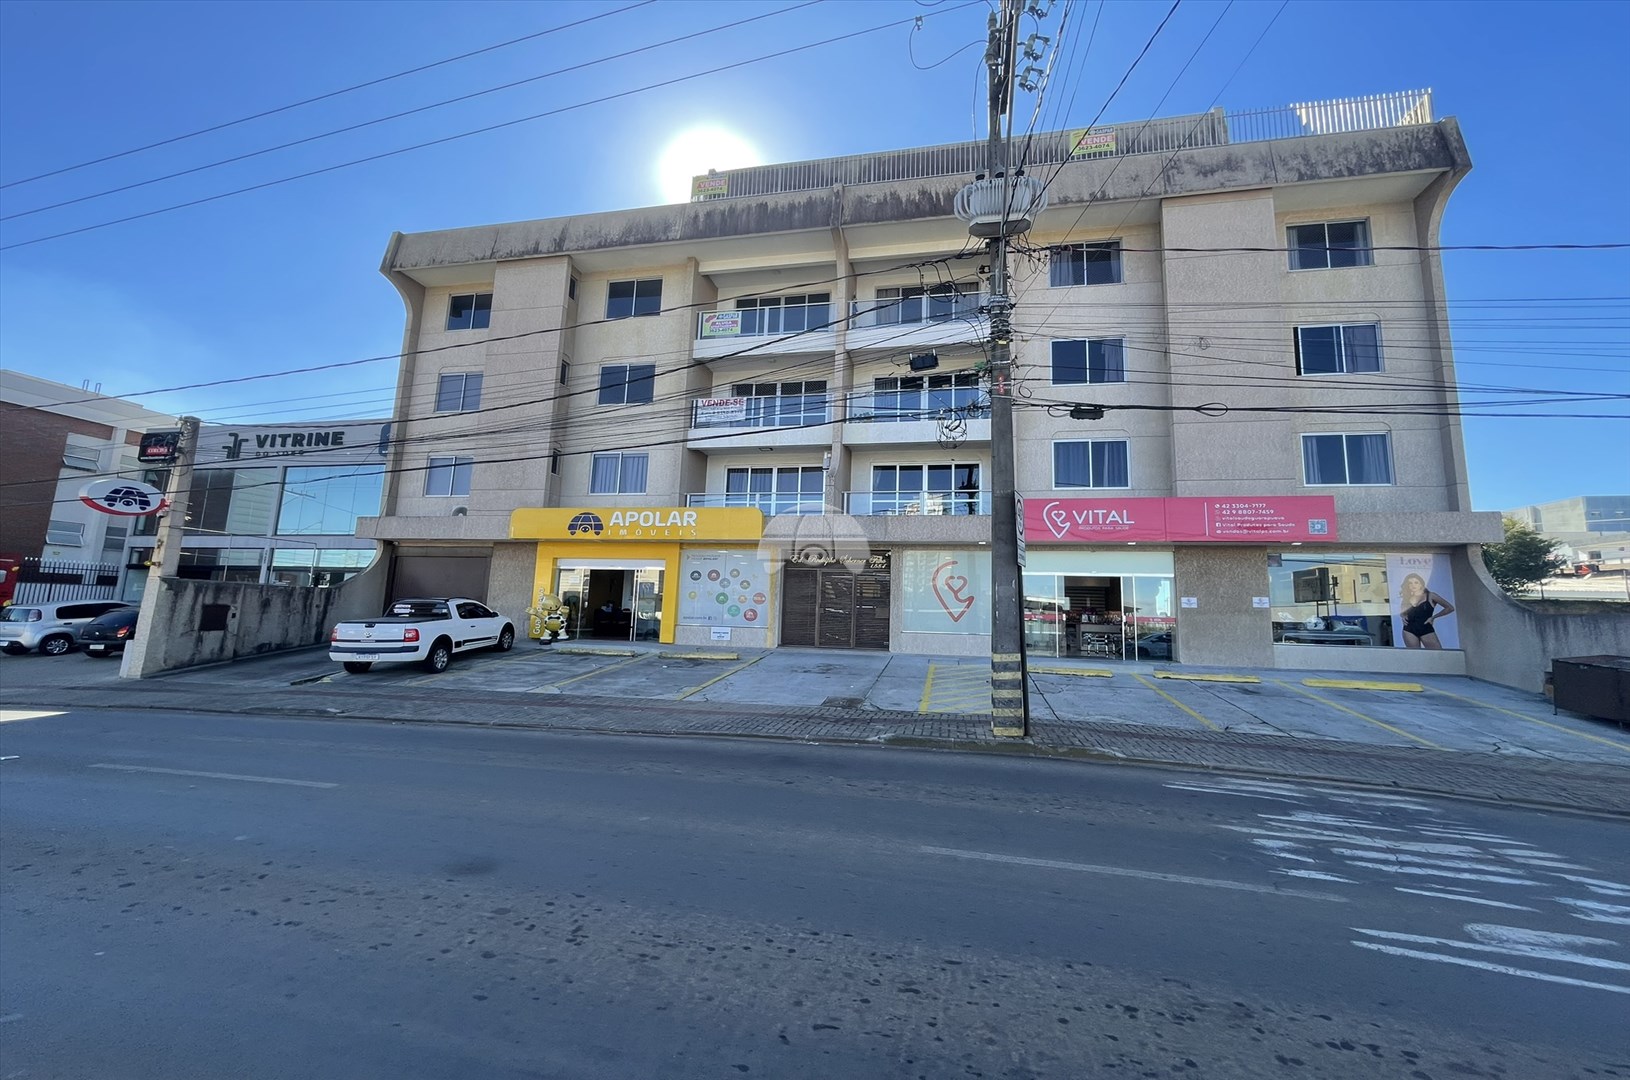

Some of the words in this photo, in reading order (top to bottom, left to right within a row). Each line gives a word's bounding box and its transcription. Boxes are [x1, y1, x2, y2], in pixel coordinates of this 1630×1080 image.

[1080, 136, 1113, 145] VENDE
[699, 180, 726, 188] VENDE
[701, 398, 745, 408] VENDE-SE
[256, 431, 345, 449] VITRINE
[609, 511, 697, 527] APOLAR
[1072, 509, 1135, 524] VITAL
